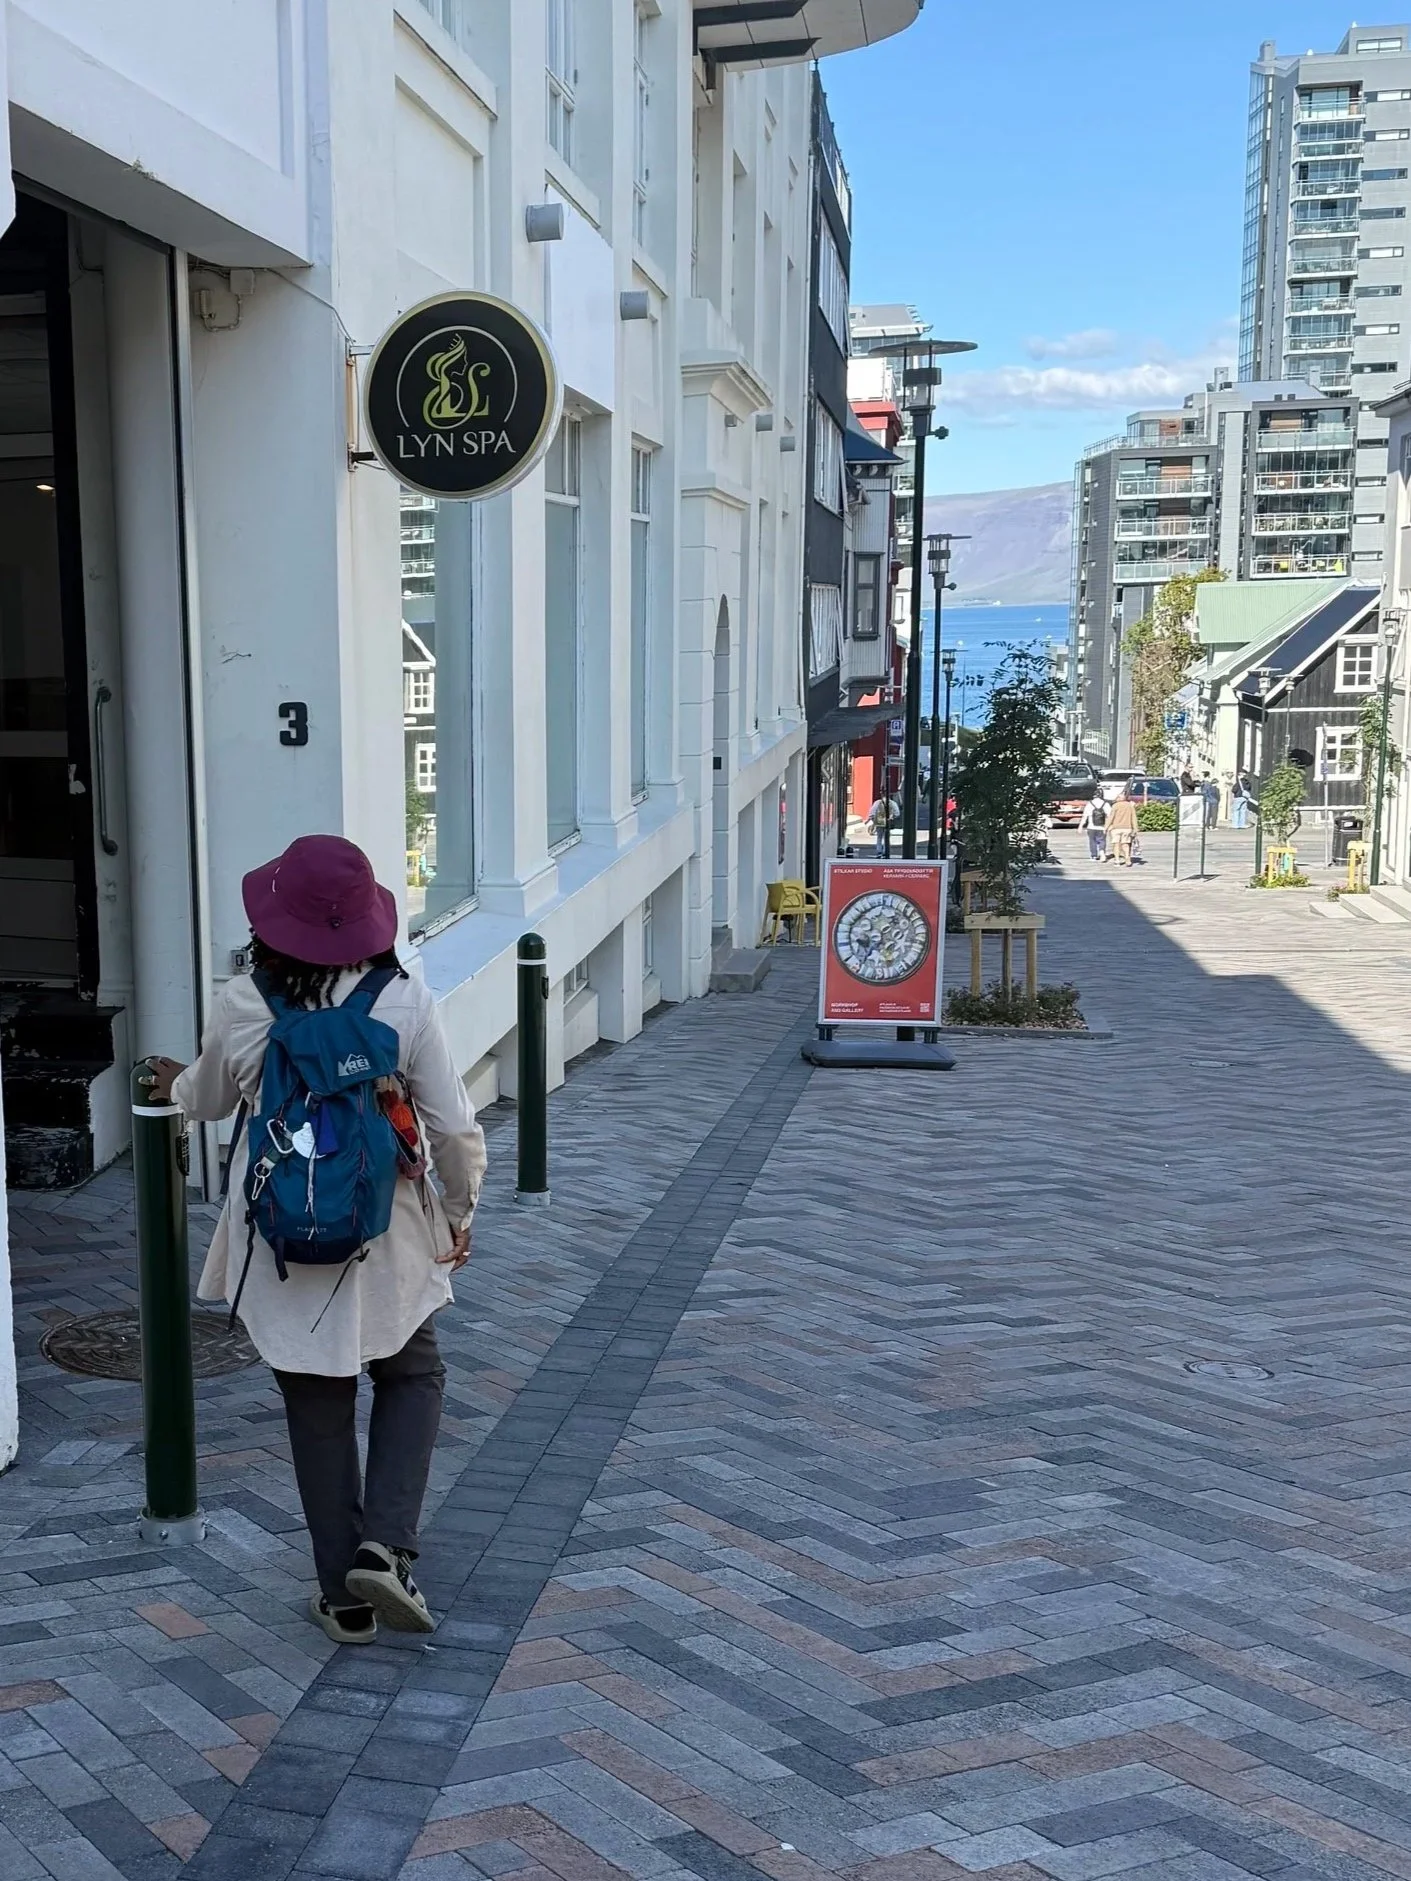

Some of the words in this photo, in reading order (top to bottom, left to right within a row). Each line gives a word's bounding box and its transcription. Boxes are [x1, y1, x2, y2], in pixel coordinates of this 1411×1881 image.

[396, 432, 454, 458] LYN
[463, 430, 517, 455] SPA
[278, 701, 309, 746] 3
